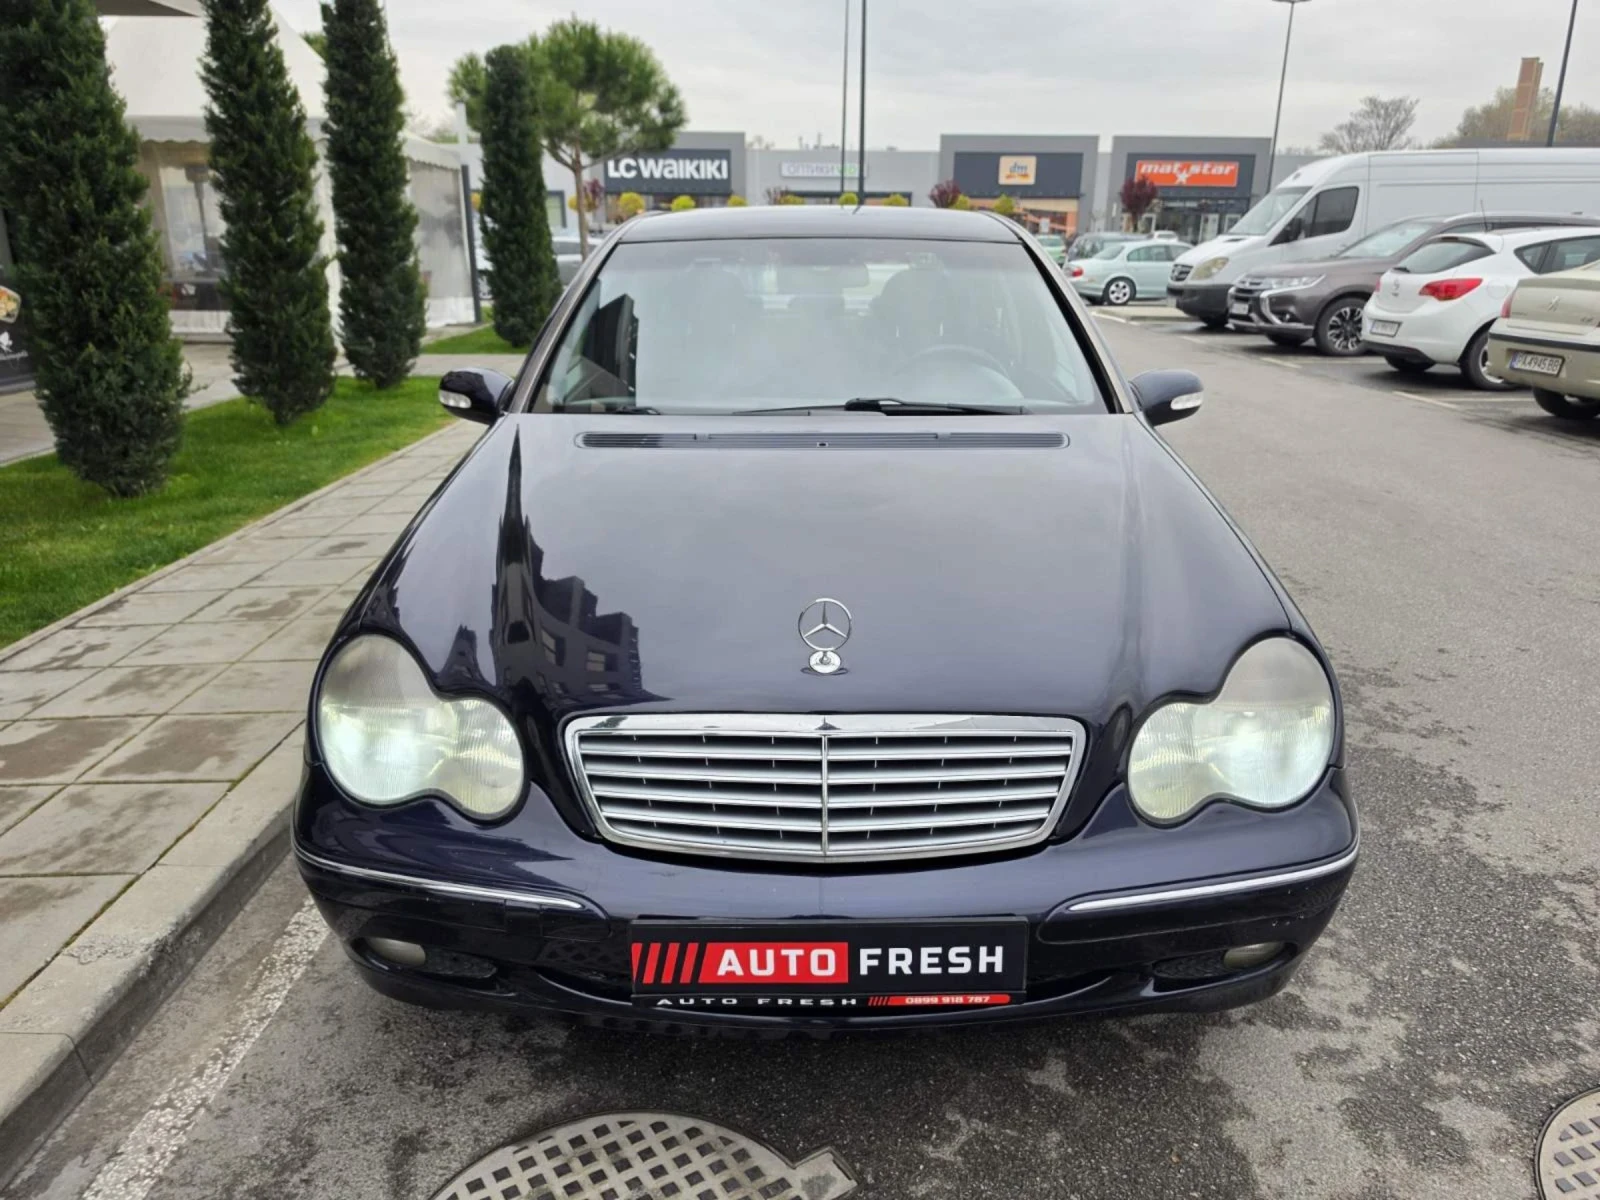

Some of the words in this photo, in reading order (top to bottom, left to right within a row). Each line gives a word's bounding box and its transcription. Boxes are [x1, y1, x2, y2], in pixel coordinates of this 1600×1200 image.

[607, 158, 637, 179] LC
[717, 949, 836, 976] AUTO
[859, 946, 1003, 975] FRESH
[657, 998, 738, 1006] AUTO
[757, 998, 857, 1006] FRESH
